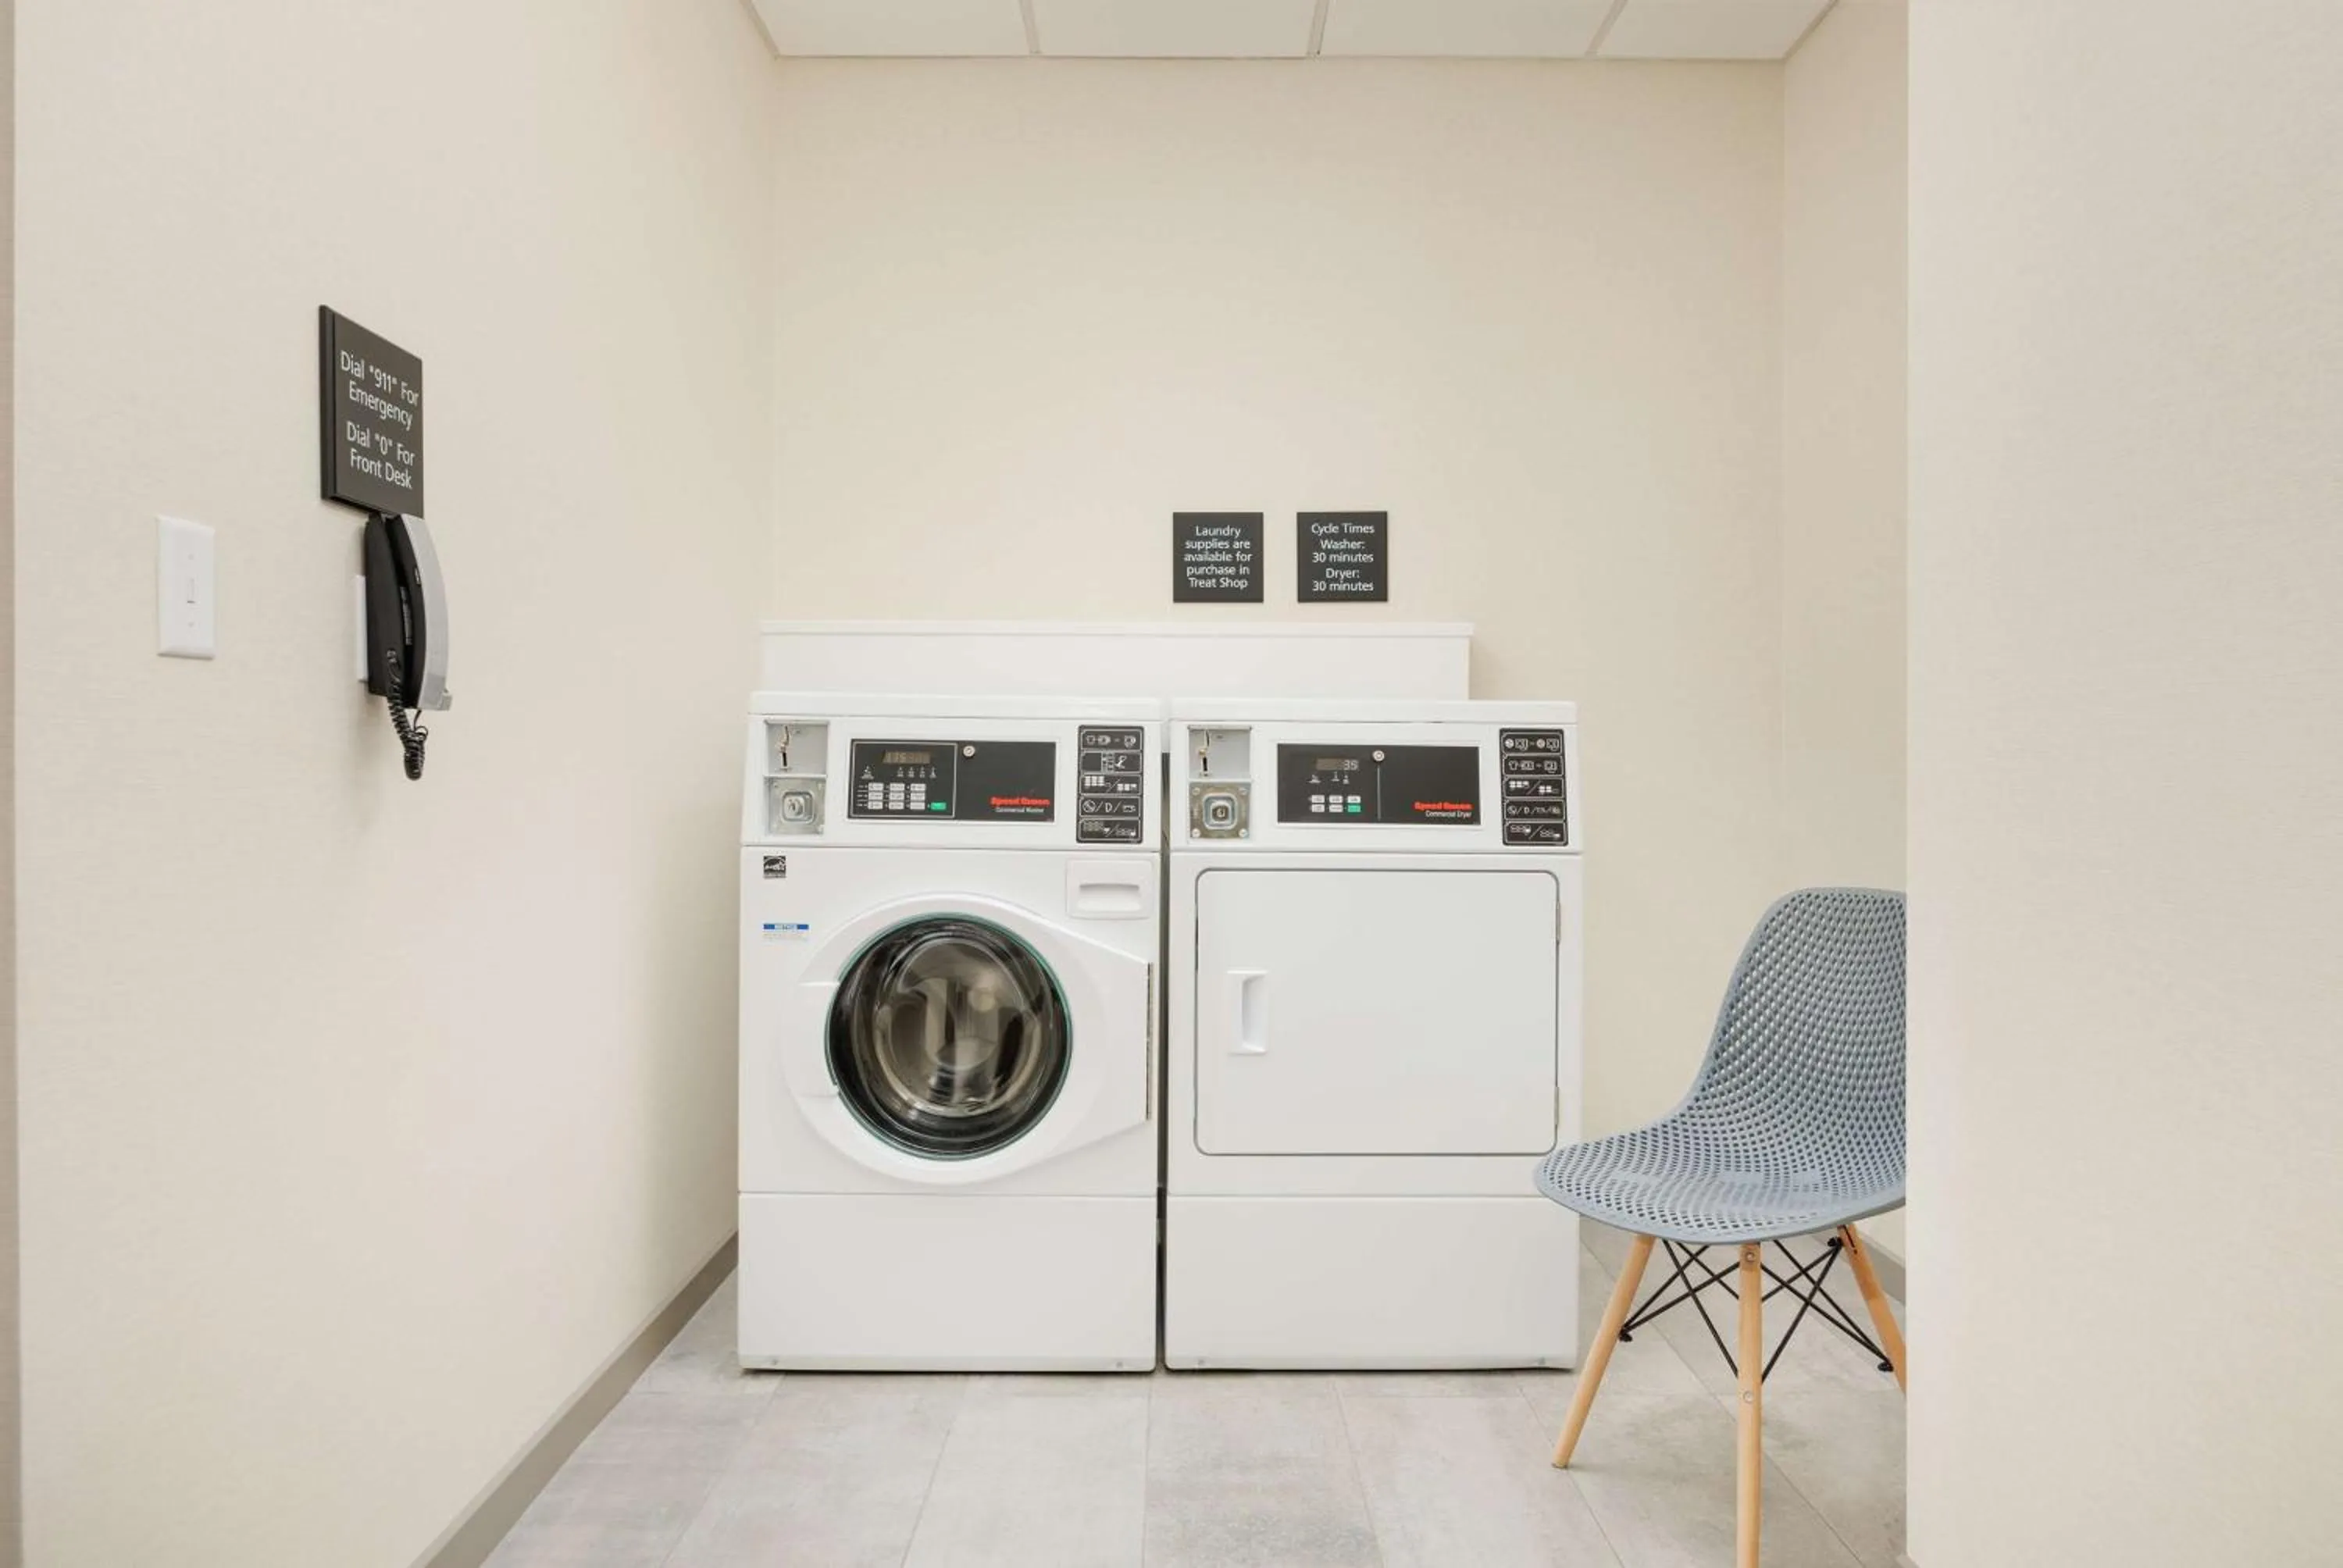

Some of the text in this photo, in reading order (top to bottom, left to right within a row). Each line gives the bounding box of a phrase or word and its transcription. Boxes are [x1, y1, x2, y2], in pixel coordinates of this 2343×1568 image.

[341, 350, 365, 380] Dial
[401, 381, 419, 407] For
[349, 379, 412, 431] Emergency
[346, 421, 370, 448] Dial
[397, 444, 415, 467] For
[350, 447, 412, 490] Front Desk
[1195, 525, 1241, 539] Laundry
[1311, 522, 1375, 536] Cycle Times
[1185, 539, 1250, 551] supplies are
[1320, 539, 1365, 549] Washer:
[1184, 551, 1253, 561] available for
[1312, 552, 1374, 562] 30 minutes
[1186, 564, 1250, 577] purchase in
[1325, 568, 1360, 580] Dryer:
[1188, 577, 1249, 590] Treat Shop
[1312, 580, 1374, 591] 30 minutes
